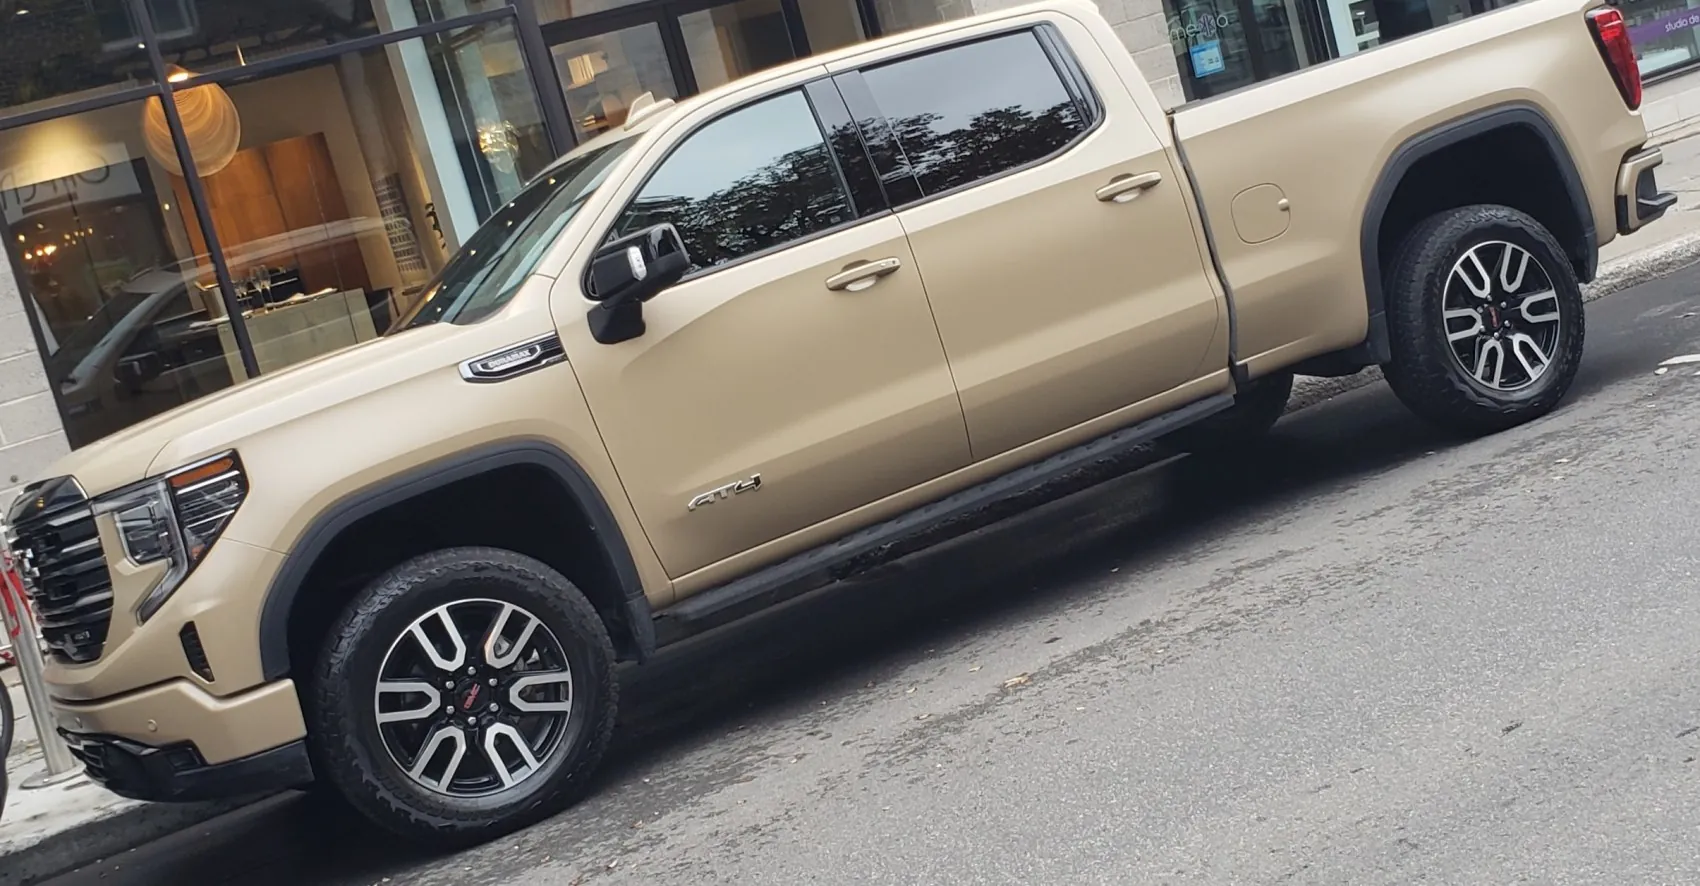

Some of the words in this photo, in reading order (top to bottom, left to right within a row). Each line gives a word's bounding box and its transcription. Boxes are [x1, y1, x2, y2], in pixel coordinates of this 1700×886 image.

[1665, 17, 1688, 32] studio
[1689, 14, 1700, 25] de
[488, 349, 531, 369] DURAMAX
[688, 473, 762, 512] AT4
